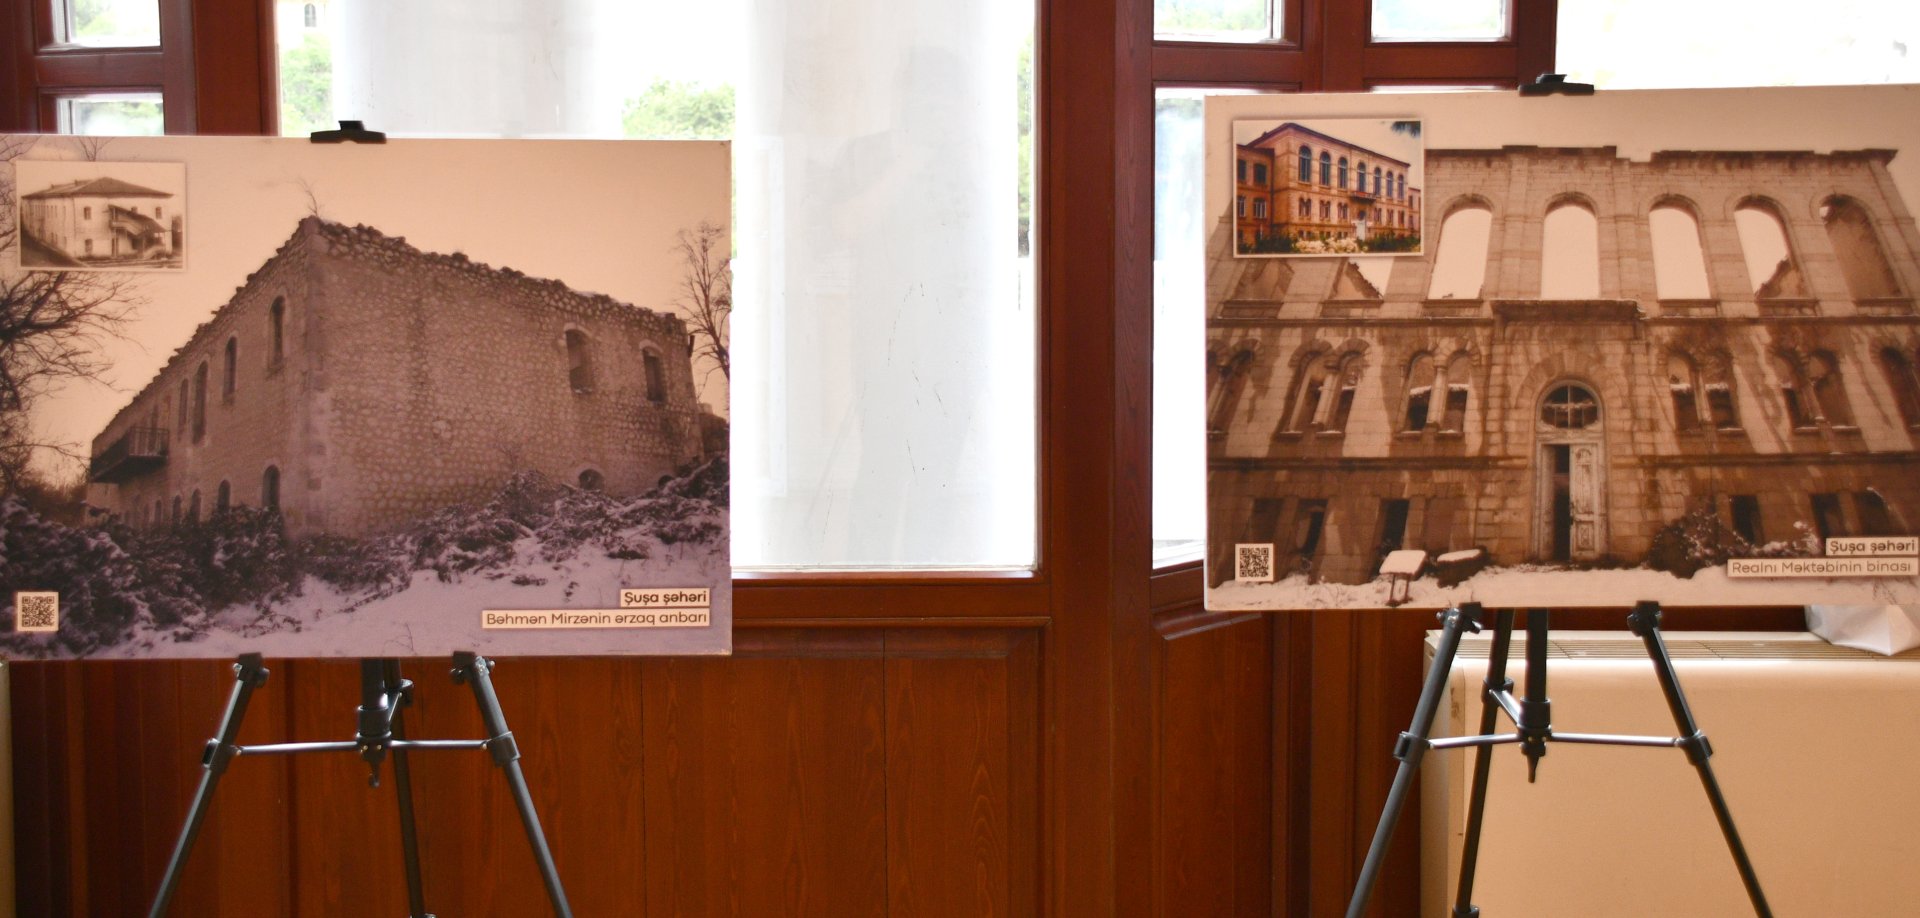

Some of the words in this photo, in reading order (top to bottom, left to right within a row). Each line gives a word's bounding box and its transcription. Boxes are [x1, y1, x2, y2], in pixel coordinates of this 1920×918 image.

[1829, 540, 1866, 555] Şuşa
[1870, 539, 1915, 555] şəhəri
[1781, 561, 1862, 574] Məktəbinin
[1866, 560, 1911, 572] binası
[624, 591, 659, 606] Şuşa
[663, 590, 707, 606] şəhəri
[486, 613, 547, 625] Bəhmən
[551, 612, 611, 624] Mirzənin
[615, 614, 656, 625] ərzaq
[659, 611, 707, 623] anbarı
